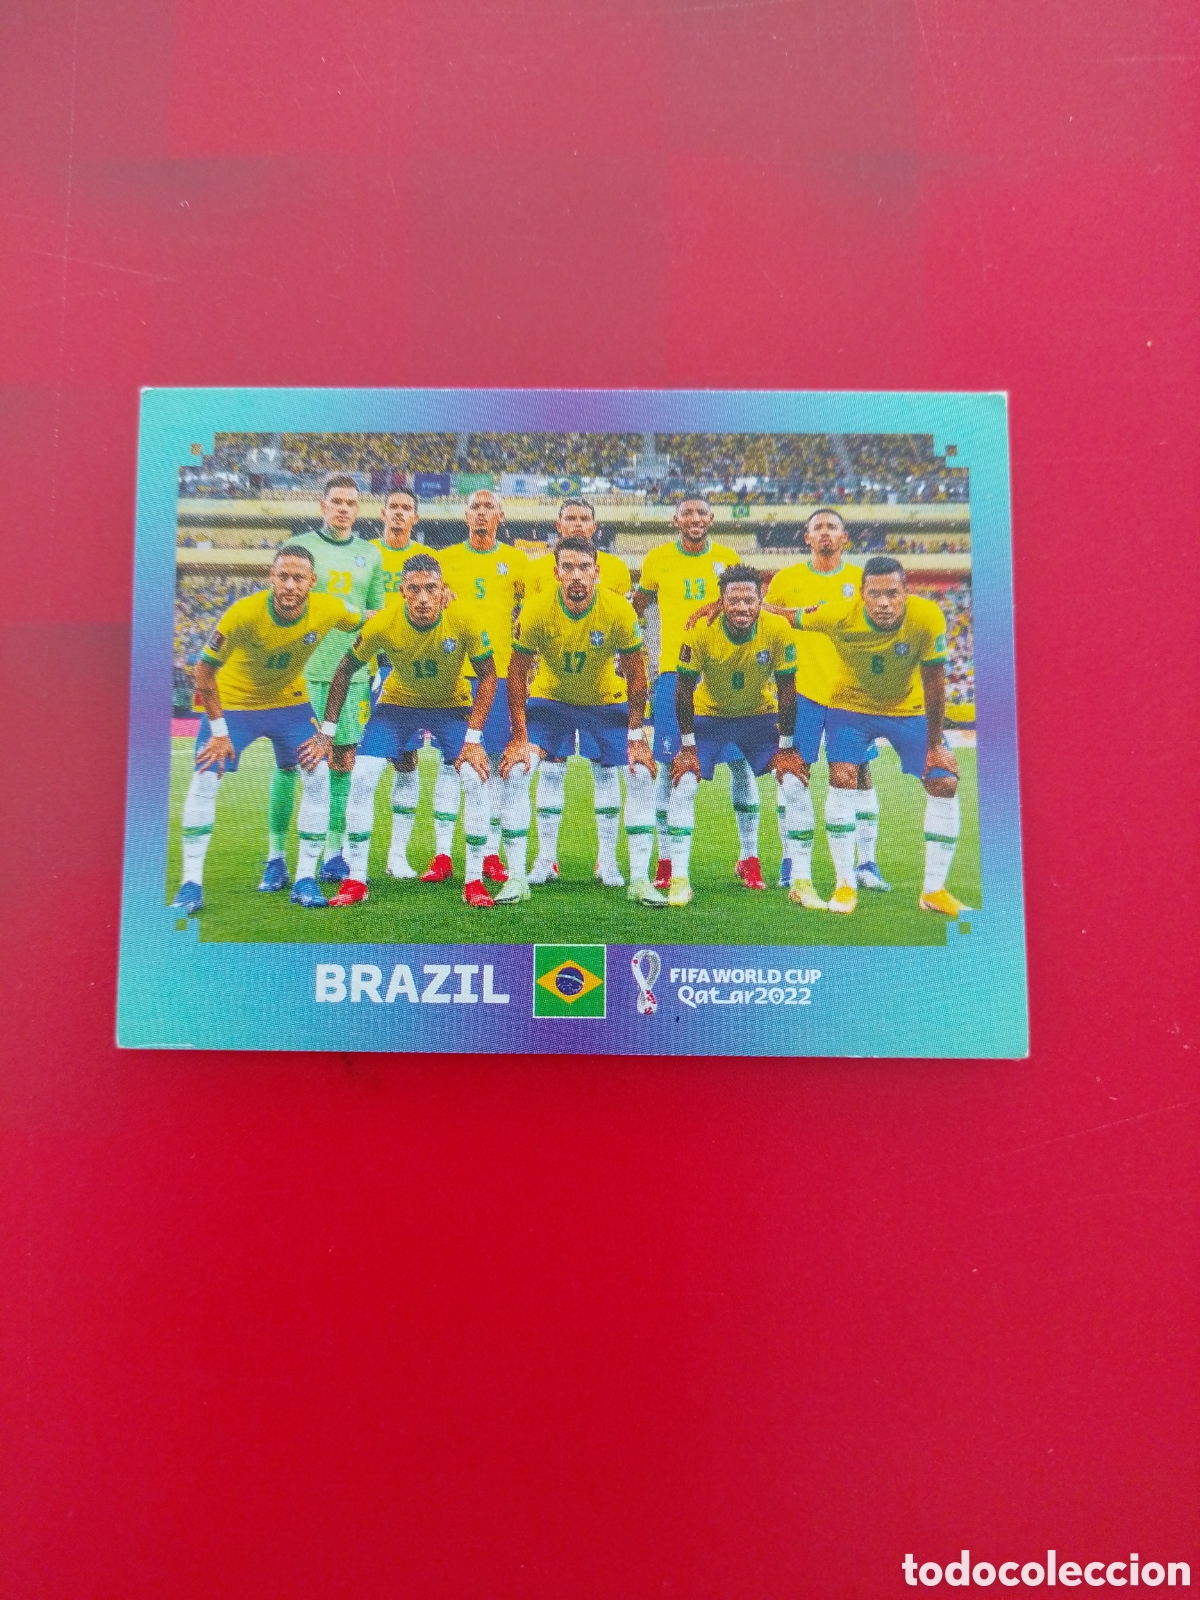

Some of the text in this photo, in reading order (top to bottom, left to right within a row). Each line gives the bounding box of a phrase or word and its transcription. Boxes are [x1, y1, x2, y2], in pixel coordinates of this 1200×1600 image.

[328, 571, 351, 593] 23
[475, 578, 486, 599] 5
[684, 578, 705, 600] 13
[413, 659, 438, 679] 19
[563, 651, 587, 674] 17
[315, 964, 510, 1004] BRAZIL
[670, 968, 822, 984] FIFA WORLD CUP
